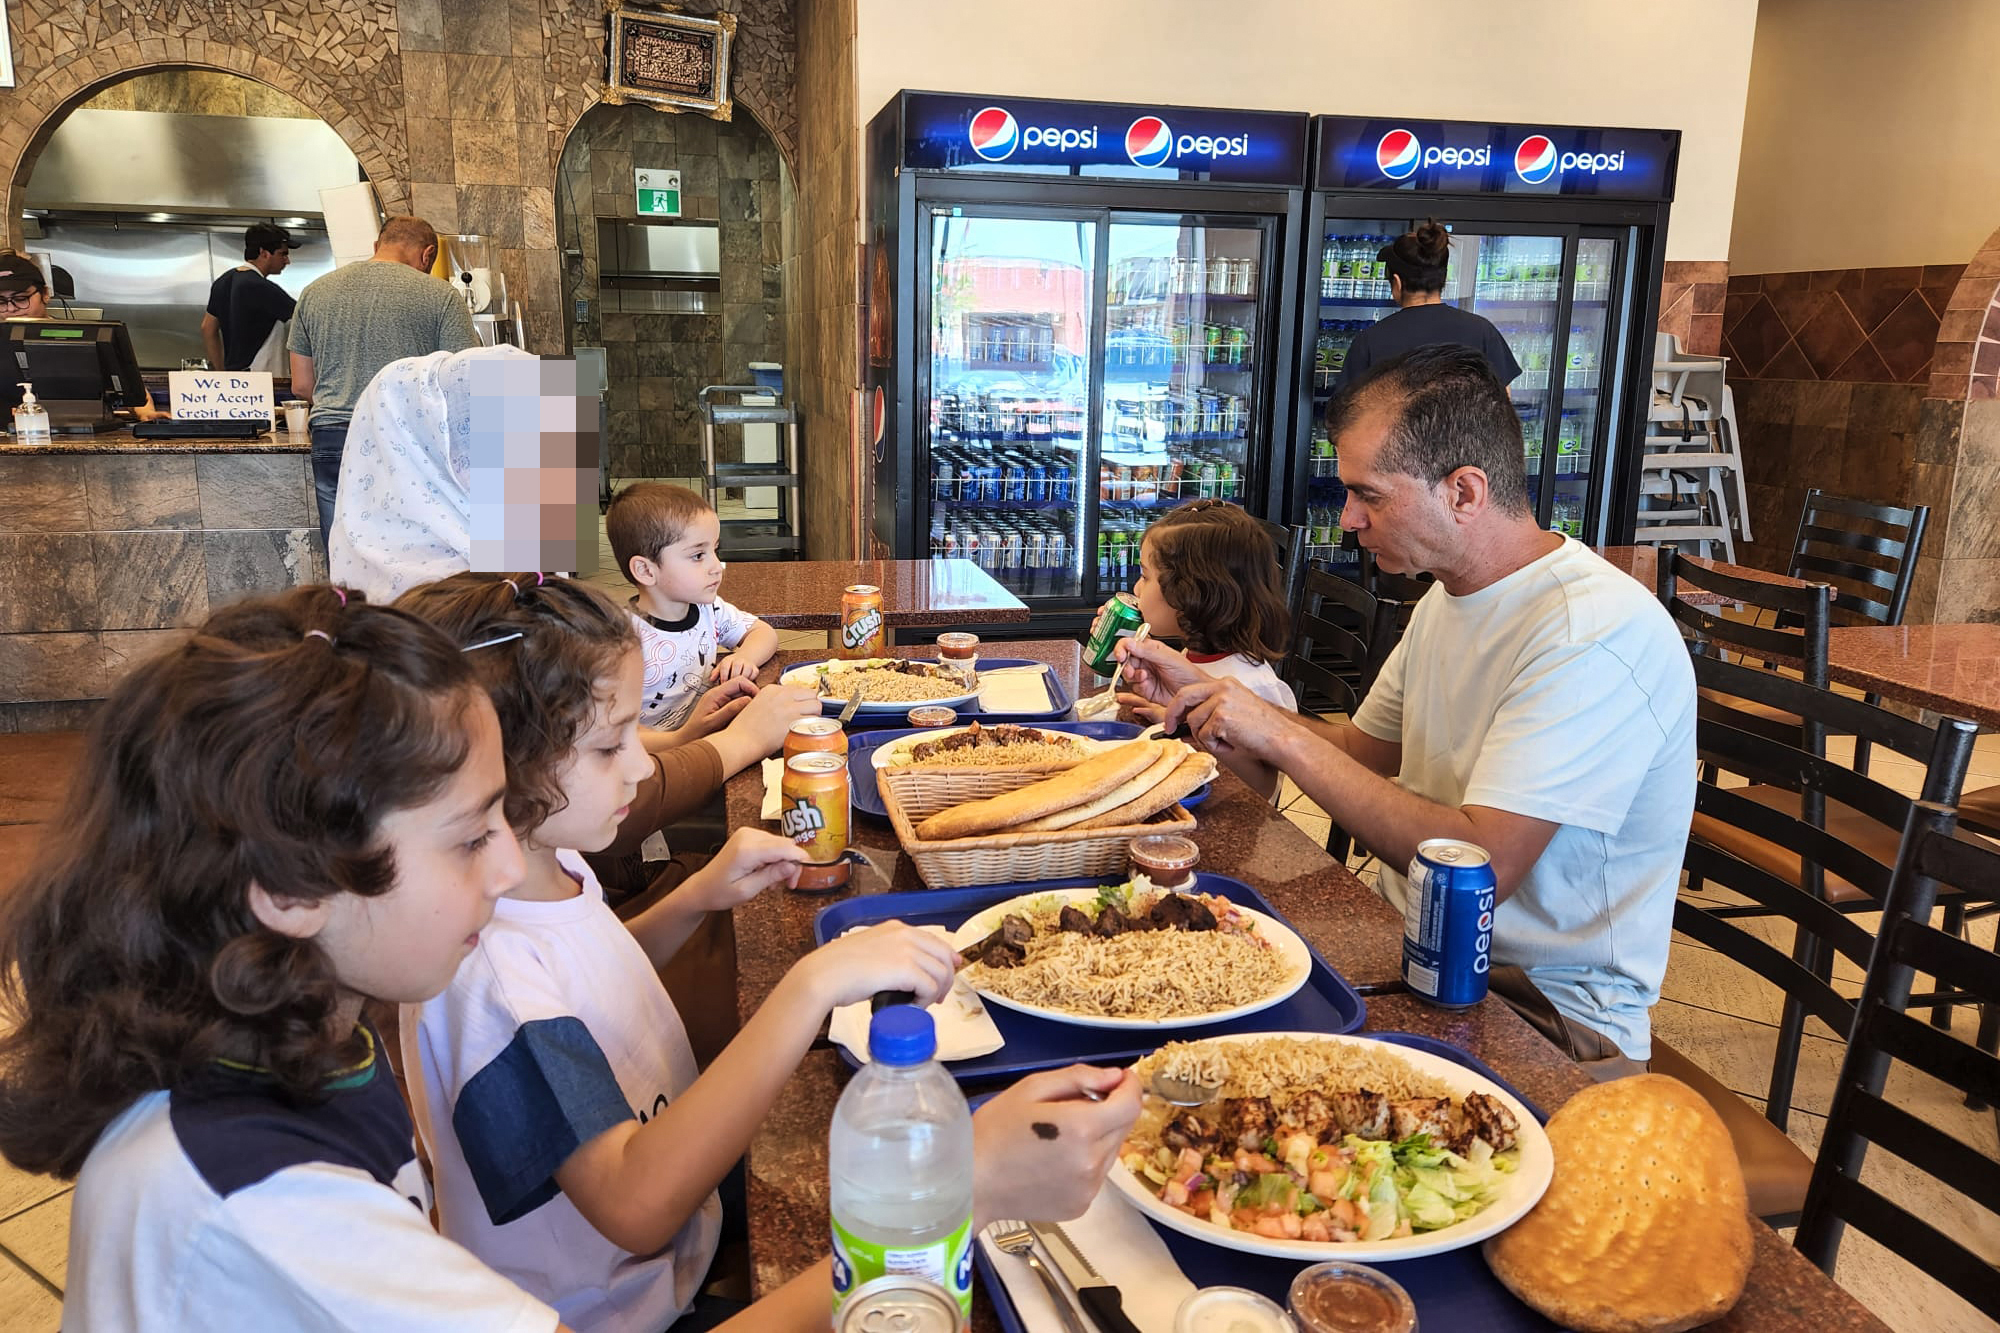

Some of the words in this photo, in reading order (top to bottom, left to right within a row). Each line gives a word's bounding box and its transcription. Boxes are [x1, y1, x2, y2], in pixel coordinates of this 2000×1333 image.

[1022, 125, 1098, 152] pepsi
[1175, 133, 1249, 160] pepsi
[1423, 144, 1491, 170] pepsi
[1559, 150, 1625, 175] pepsi
[181, 393, 208, 403] Not
[216, 392, 264, 405] Accept
[194, 378, 221, 389] We
[230, 378, 249, 389] Do
[176, 408, 219, 419] Credit
[229, 408, 269, 419] Cards
[842, 608, 881, 648] Crush
[783, 800, 822, 836] ush
[794, 830, 816, 843] nge
[1473, 885, 1495, 974] pepsi
